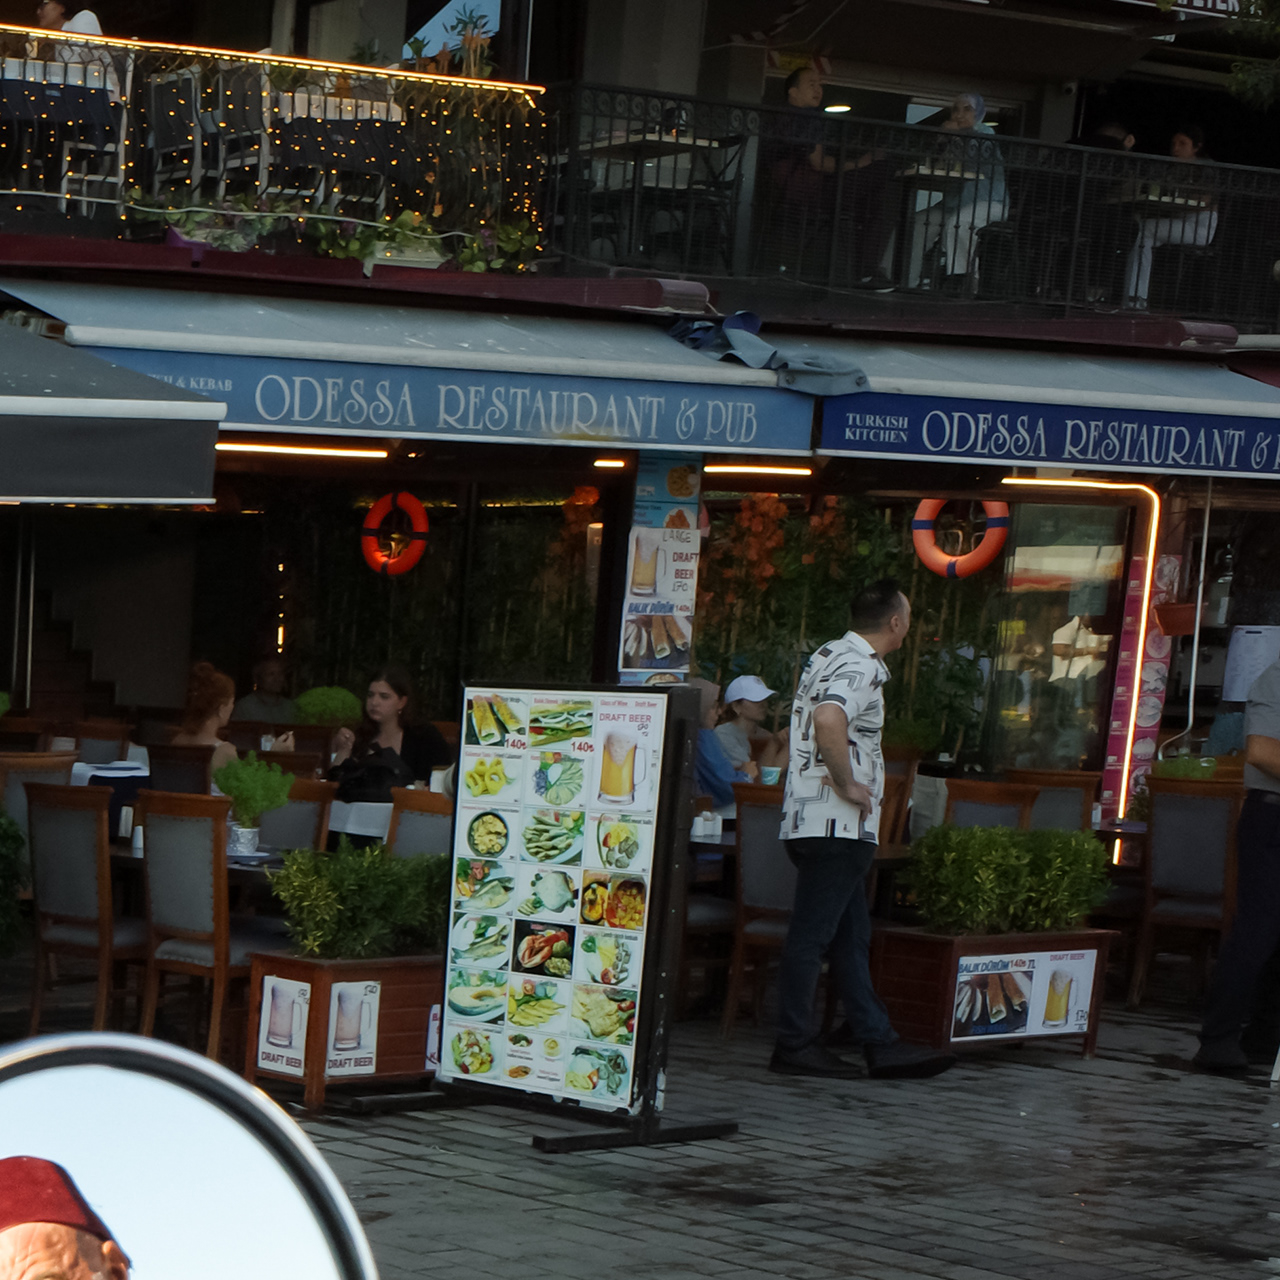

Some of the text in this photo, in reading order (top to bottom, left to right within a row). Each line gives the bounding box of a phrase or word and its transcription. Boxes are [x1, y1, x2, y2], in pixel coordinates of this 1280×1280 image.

[190, 377, 232, 391] KEBAB
[255, 374, 758, 444] ODESSA RESTAURANT & PUB
[845, 412, 909, 430] TURKISH
[844, 427, 909, 444] KITCHEN
[922, 409, 1048, 458] ODESSA
[1062, 418, 1246, 468] RESTAURANT
[1250, 431, 1272, 470] &
[662, 530, 692, 543] LARGE
[672, 551, 699, 563] DRAFT
[674, 568, 694, 580] BEER
[599, 712, 652, 724] DRAFT BEER
[1049, 952, 1085, 962] DRAFT BEER
[958, 962, 981, 974] BALIK
[261, 1051, 303, 1070] DRAFT BEER
[328, 1056, 374, 1070] DRAFT BEER
